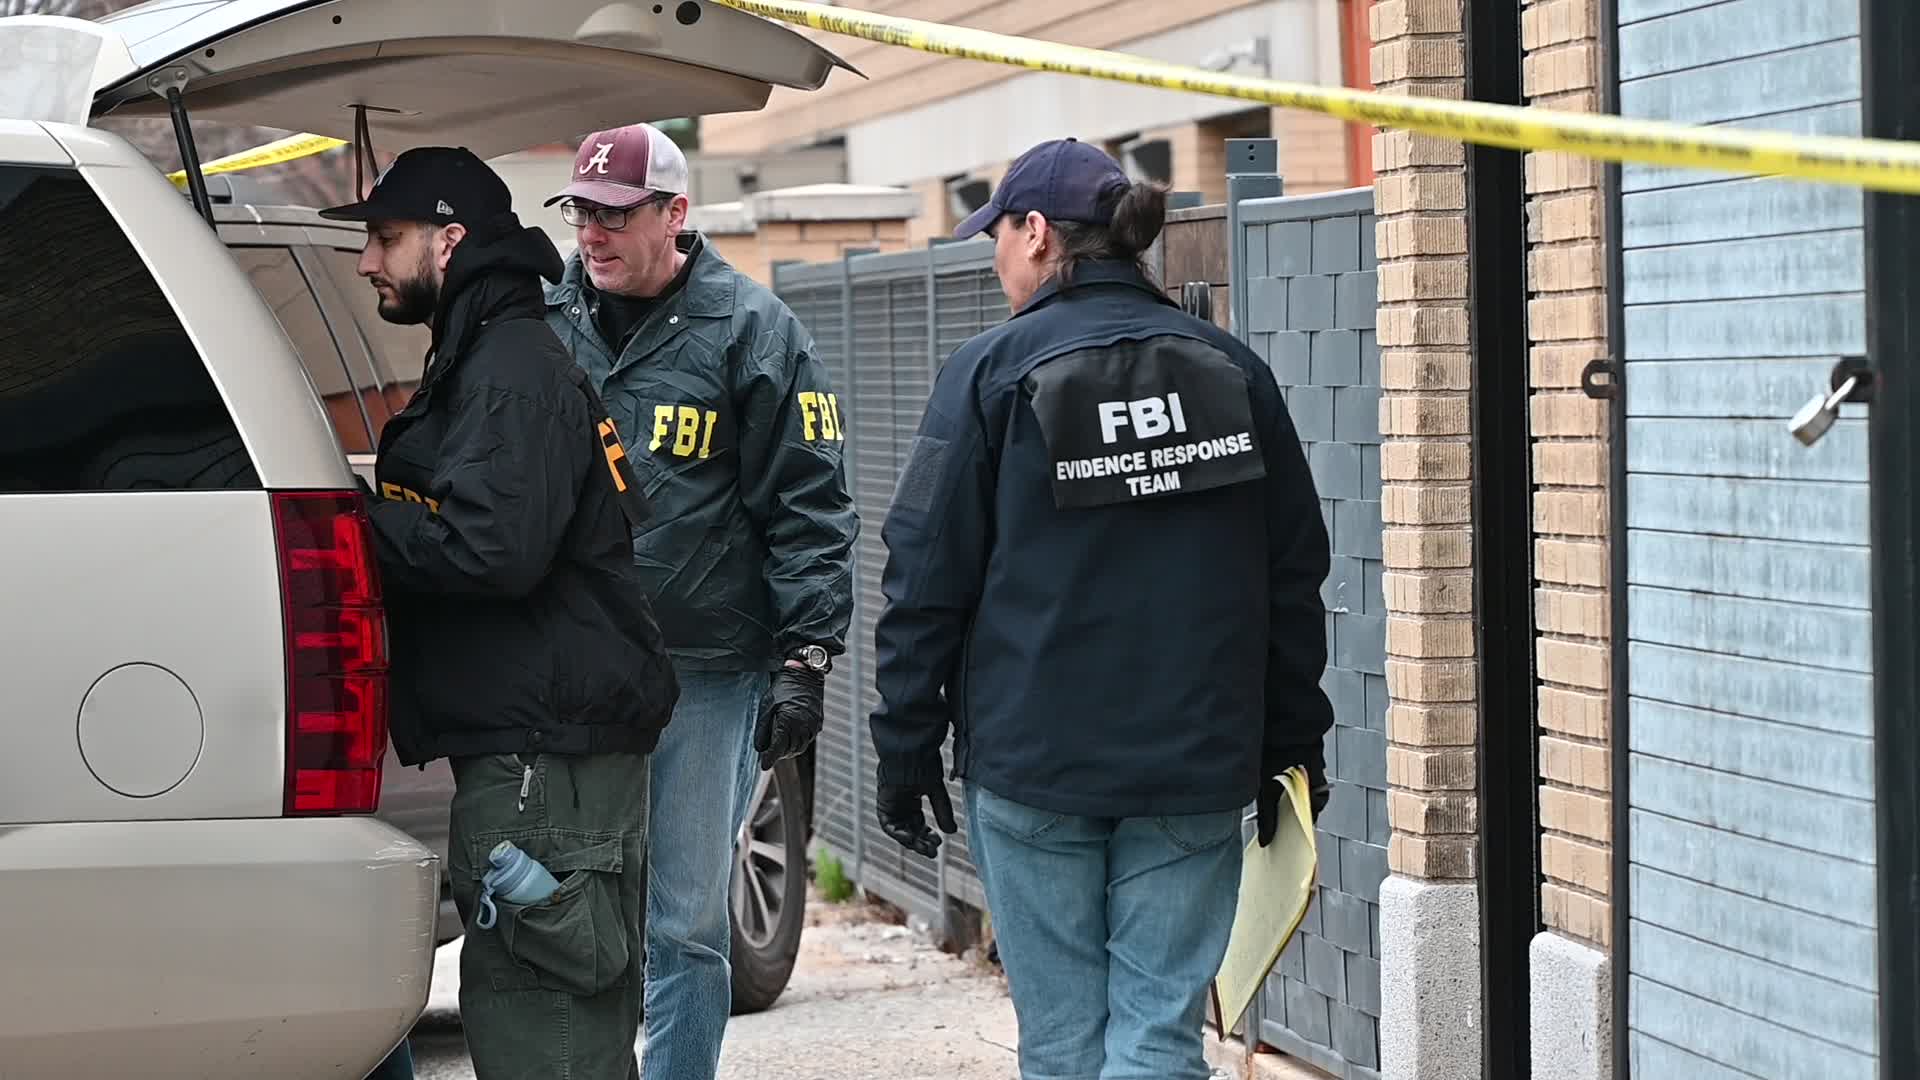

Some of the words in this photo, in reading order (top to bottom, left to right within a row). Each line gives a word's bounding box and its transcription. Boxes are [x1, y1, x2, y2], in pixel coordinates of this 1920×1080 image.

[579, 142, 615, 175] A
[648, 404, 717, 459] FBI
[797, 391, 845, 441] FBI
[1098, 392, 1187, 444] FBI
[1056, 452, 1147, 480] EVIDENCE
[1151, 432, 1253, 468] RESPONSE
[1125, 471, 1181, 497] TEAM
